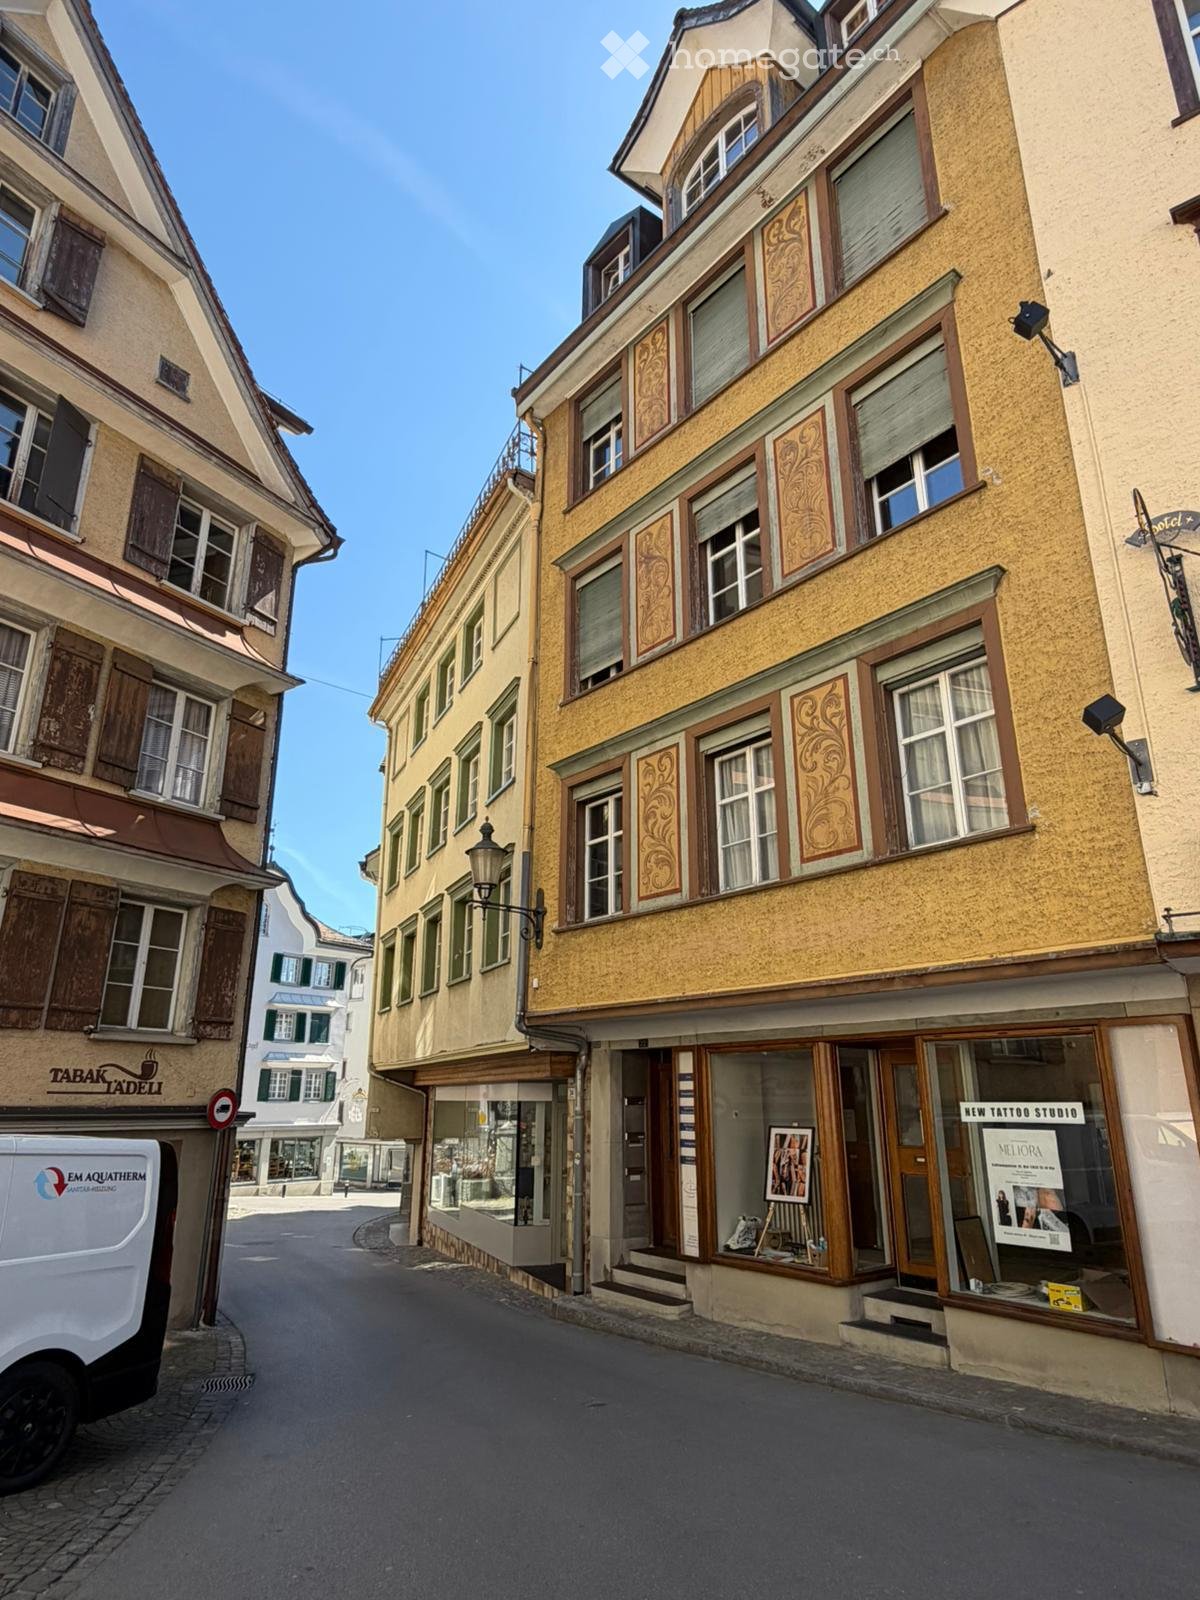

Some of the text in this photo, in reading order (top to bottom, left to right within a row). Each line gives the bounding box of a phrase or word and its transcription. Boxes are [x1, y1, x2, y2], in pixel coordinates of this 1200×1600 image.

[49, 1067, 108, 1084] TABAK
[106, 1079, 163, 1095] LÄDELI
[964, 1107, 1078, 1119] NEW TATTOO STUDIO
[998, 1143, 1043, 1158] MELIORA
[67, 1171, 146, 1184] EM AQUATHERM
